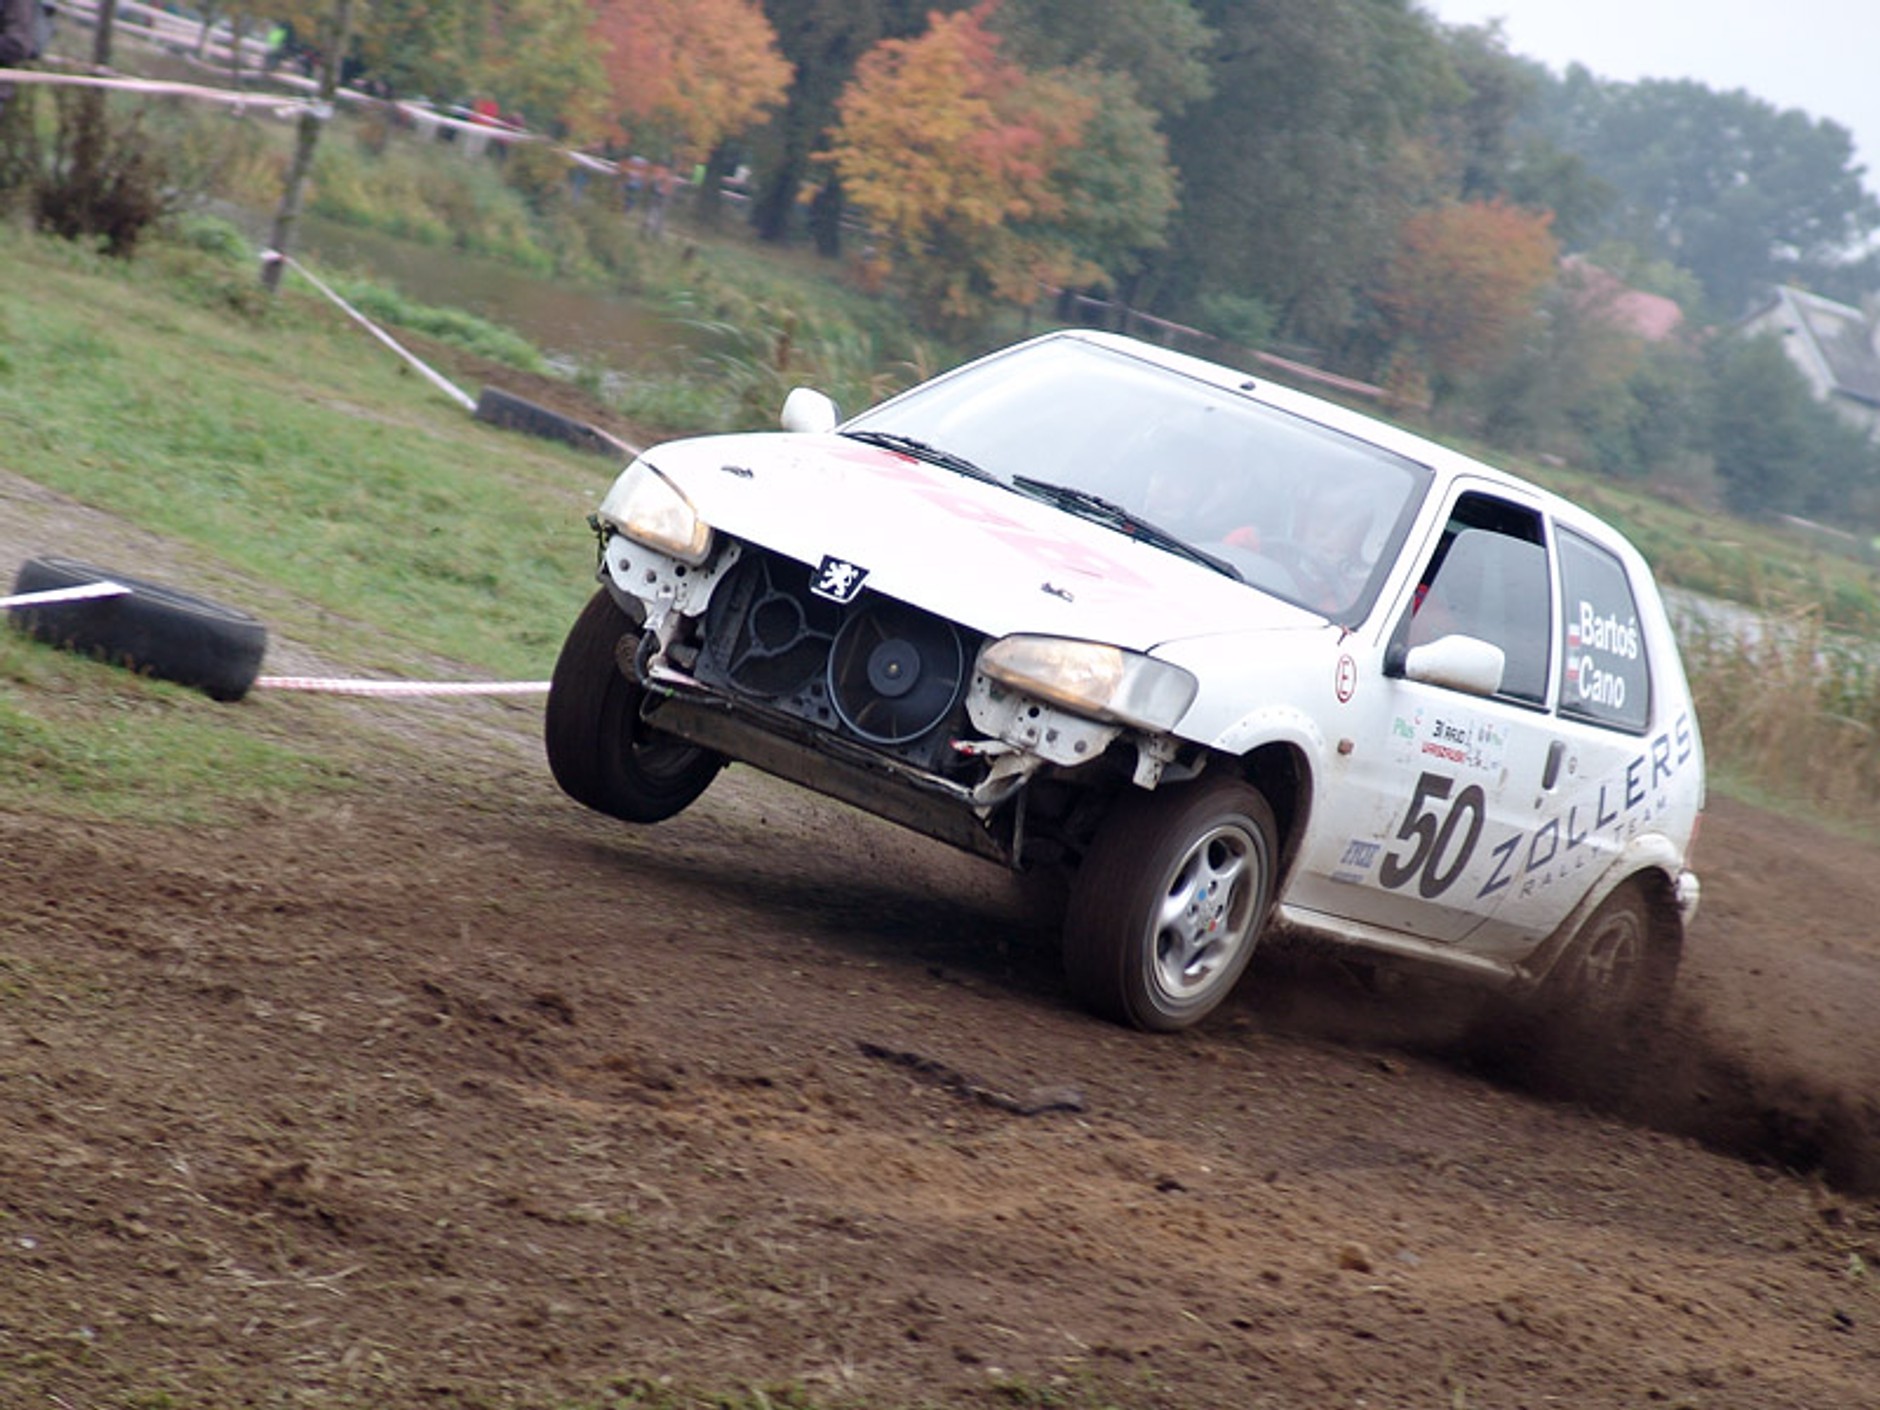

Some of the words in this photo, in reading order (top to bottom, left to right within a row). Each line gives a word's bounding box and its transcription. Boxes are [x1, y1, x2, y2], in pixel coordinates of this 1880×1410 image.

[1579, 600, 1638, 660] Bartoś
[1578, 655, 1626, 709] Cano
[1378, 771, 1486, 899] 50
[1476, 711, 1691, 899] ZOLLERS
